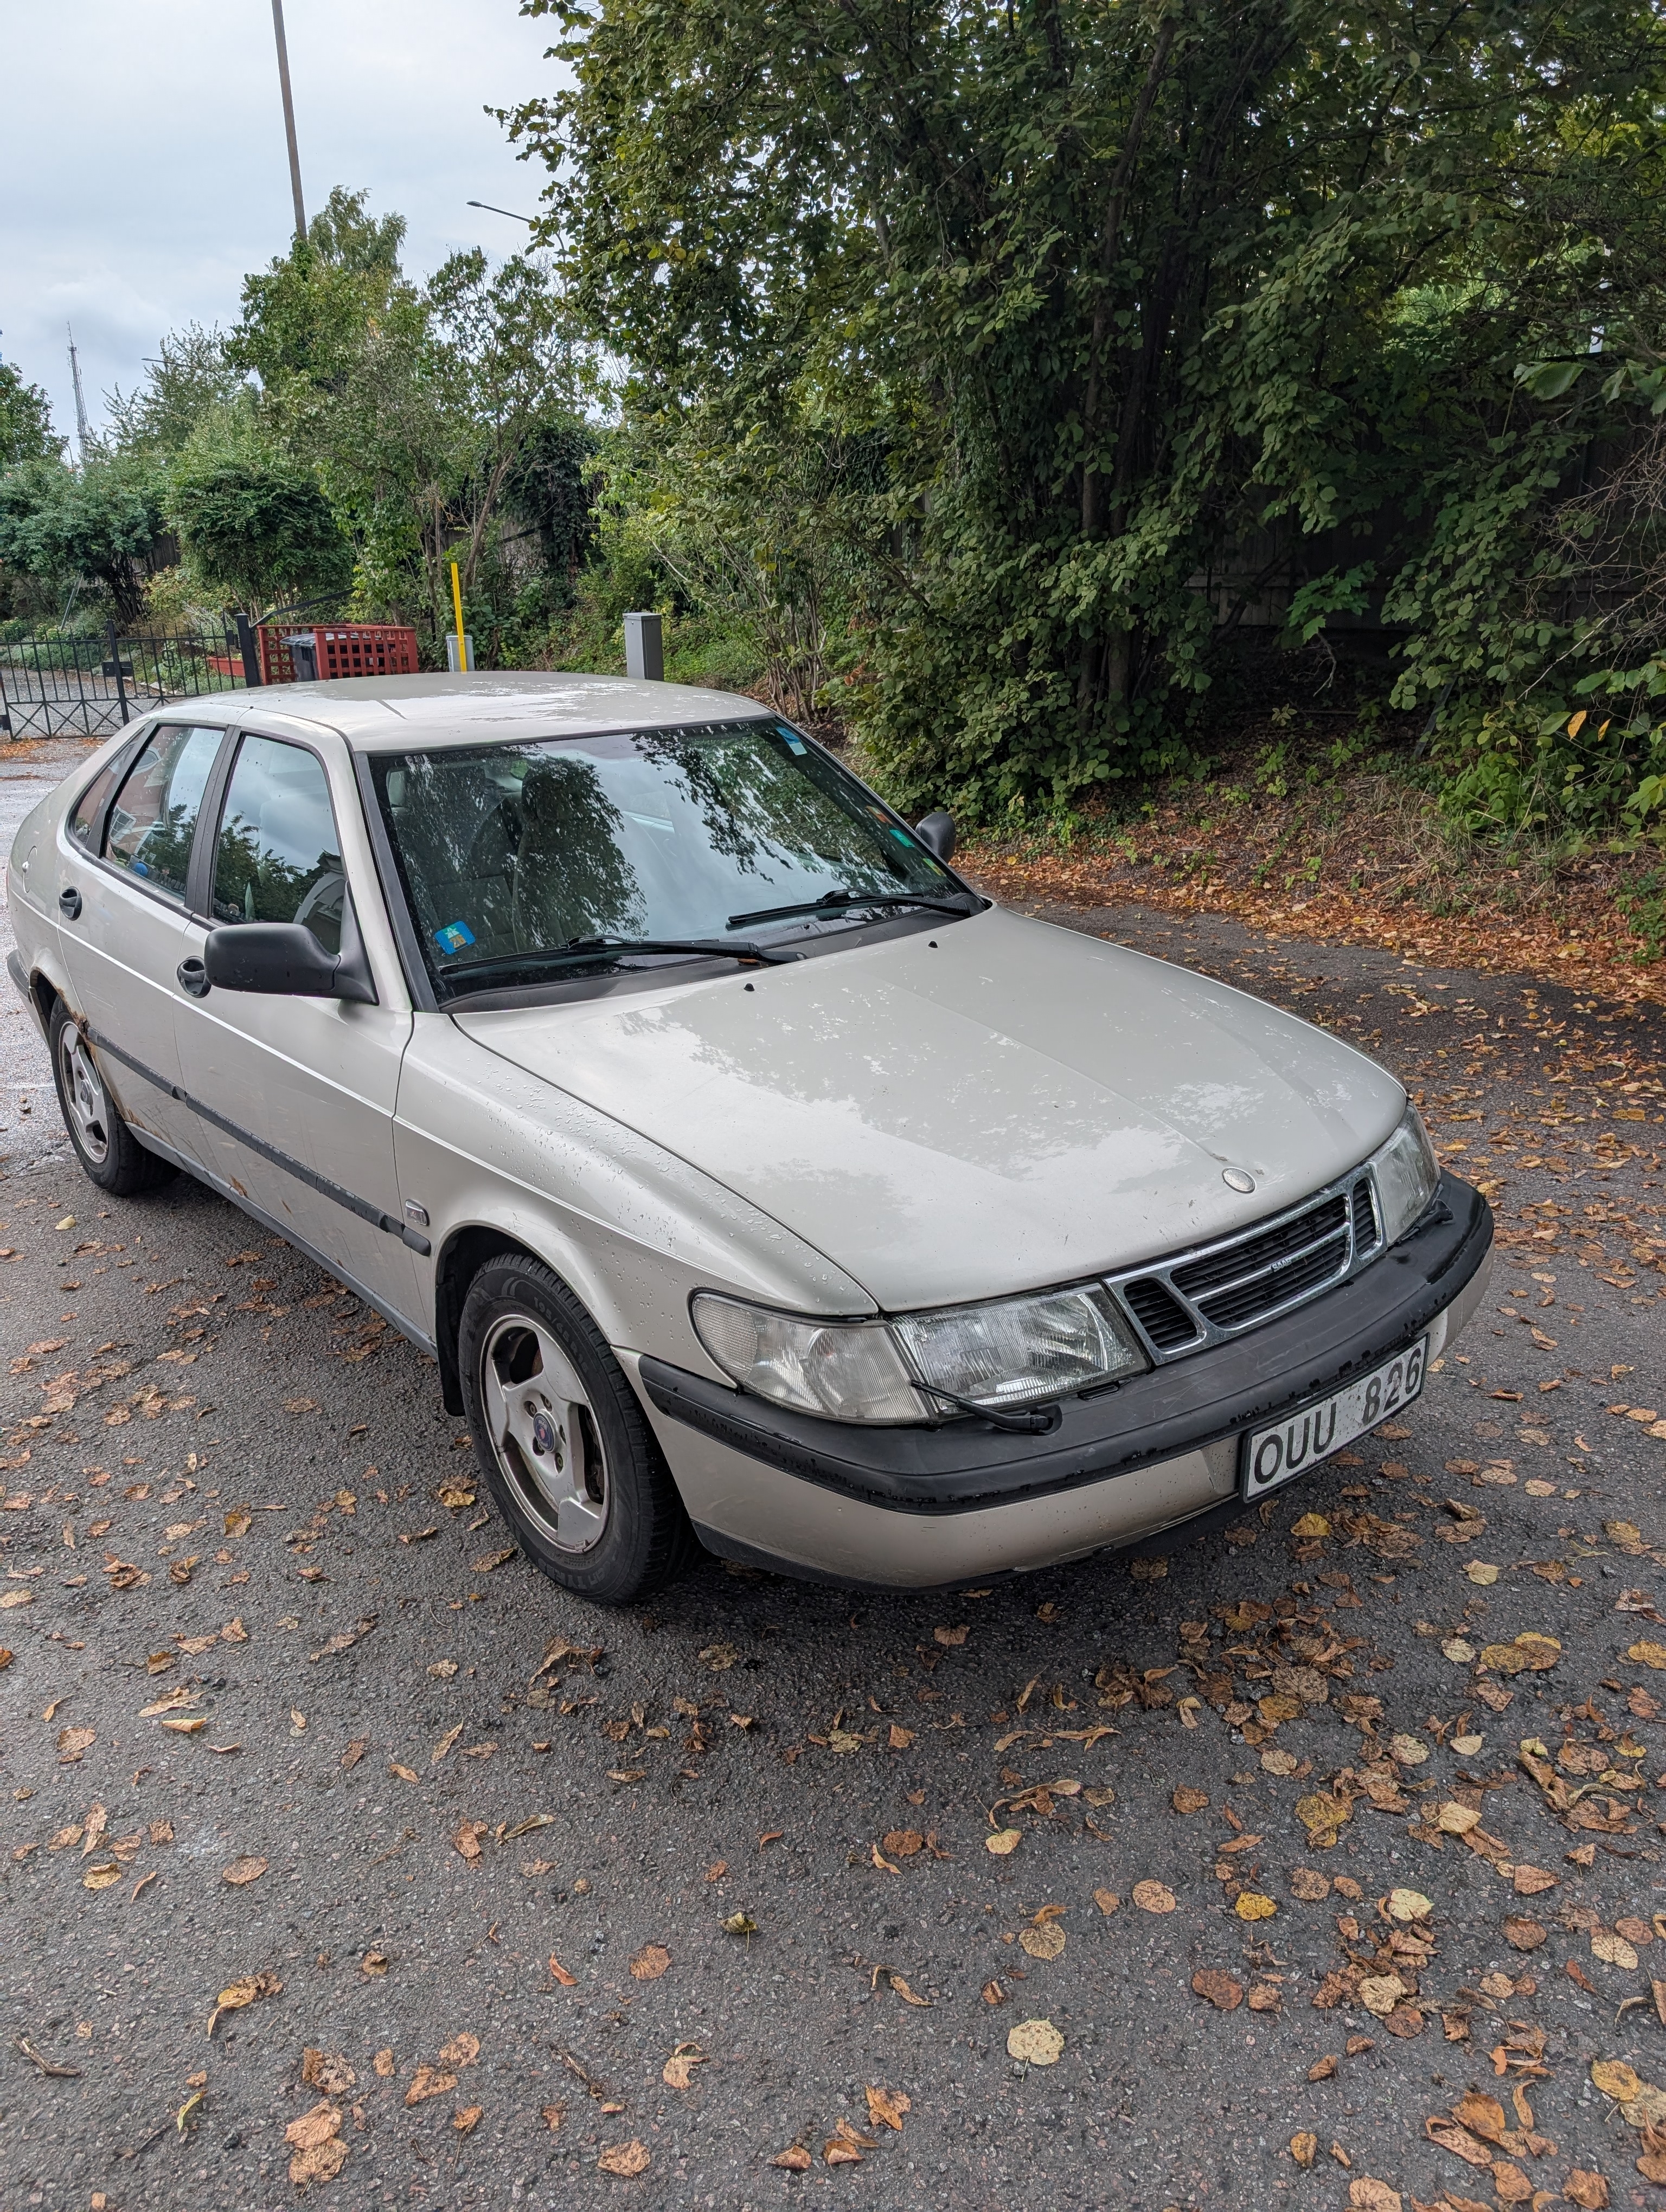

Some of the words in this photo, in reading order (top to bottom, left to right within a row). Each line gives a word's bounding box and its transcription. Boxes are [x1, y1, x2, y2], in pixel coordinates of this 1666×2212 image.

[162, 650, 175, 667] 9
[1272, 1258, 1292, 1272] SAAB
[1254, 1401, 1337, 1484] OUU
[1362, 1347, 1421, 1425] 826
